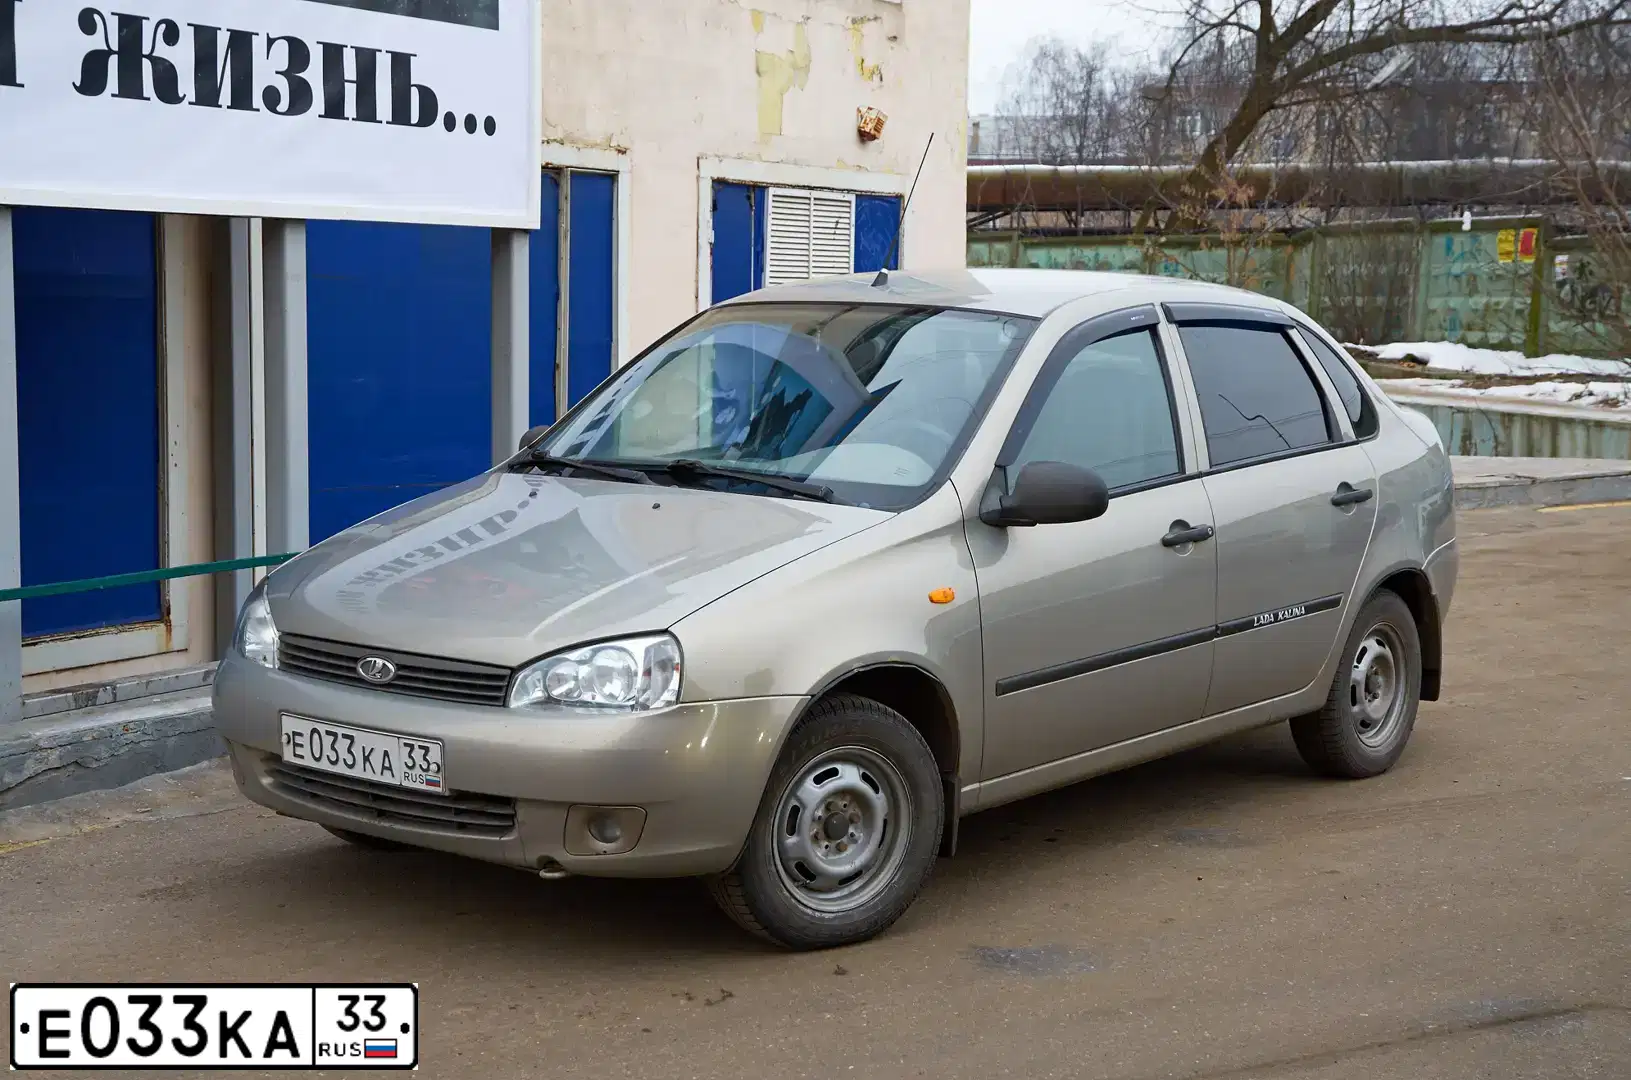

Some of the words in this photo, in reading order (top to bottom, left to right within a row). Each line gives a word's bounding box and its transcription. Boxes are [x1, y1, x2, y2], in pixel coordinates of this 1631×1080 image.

[1254, 613, 1274, 626] LADA
[1278, 606, 1305, 620] KALINA
[402, 742, 432, 773] 33
[403, 771, 425, 784] RUS
